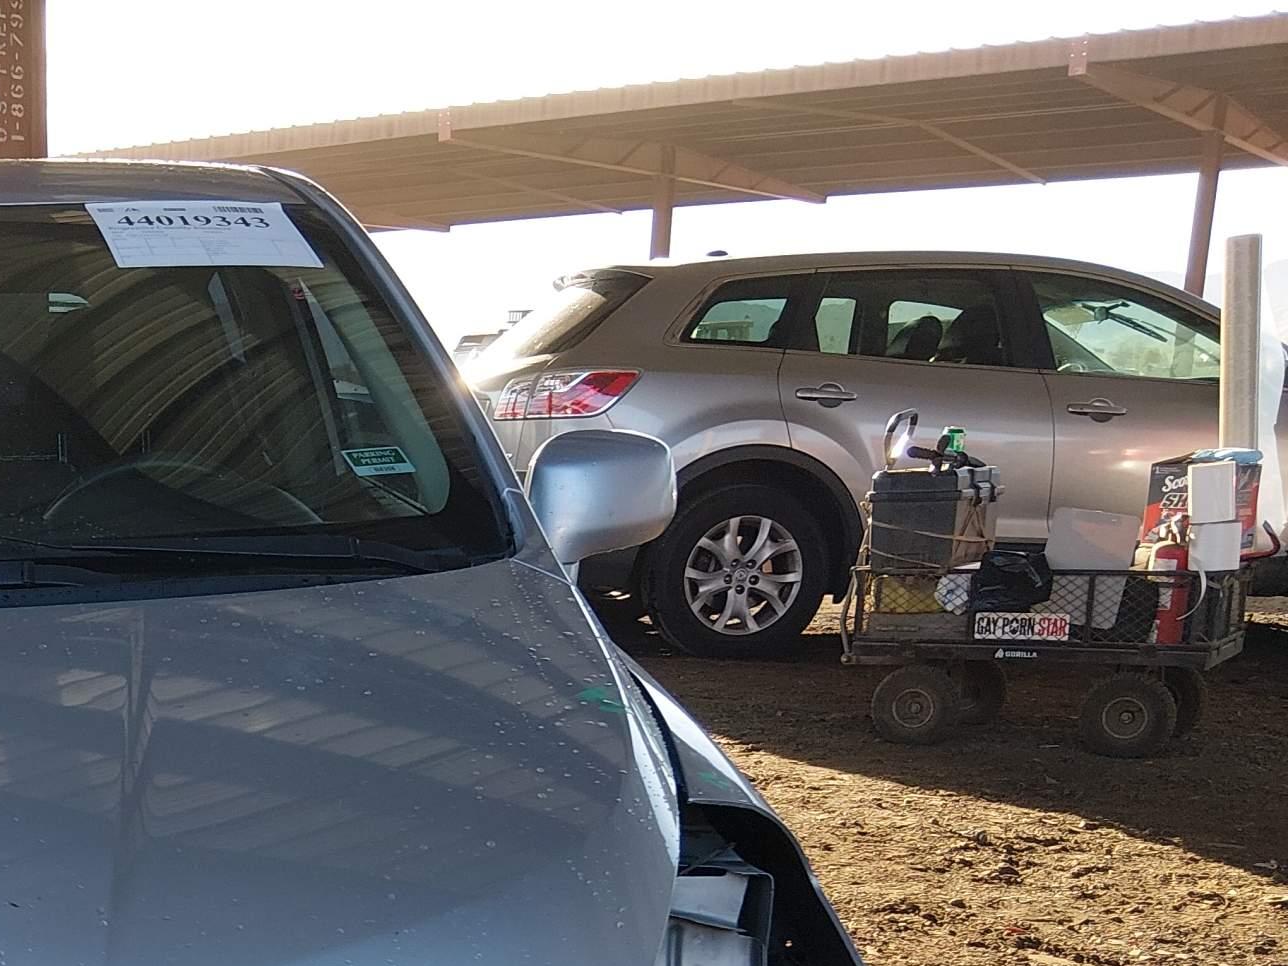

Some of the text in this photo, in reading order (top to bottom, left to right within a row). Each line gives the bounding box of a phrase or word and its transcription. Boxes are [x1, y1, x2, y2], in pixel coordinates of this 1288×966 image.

[117, 215, 270, 229] 44019343
[352, 449, 395, 458] PARKING
[360, 456, 395, 465] PERMIT
[976, 617, 1068, 637] GAY PORN STAR
